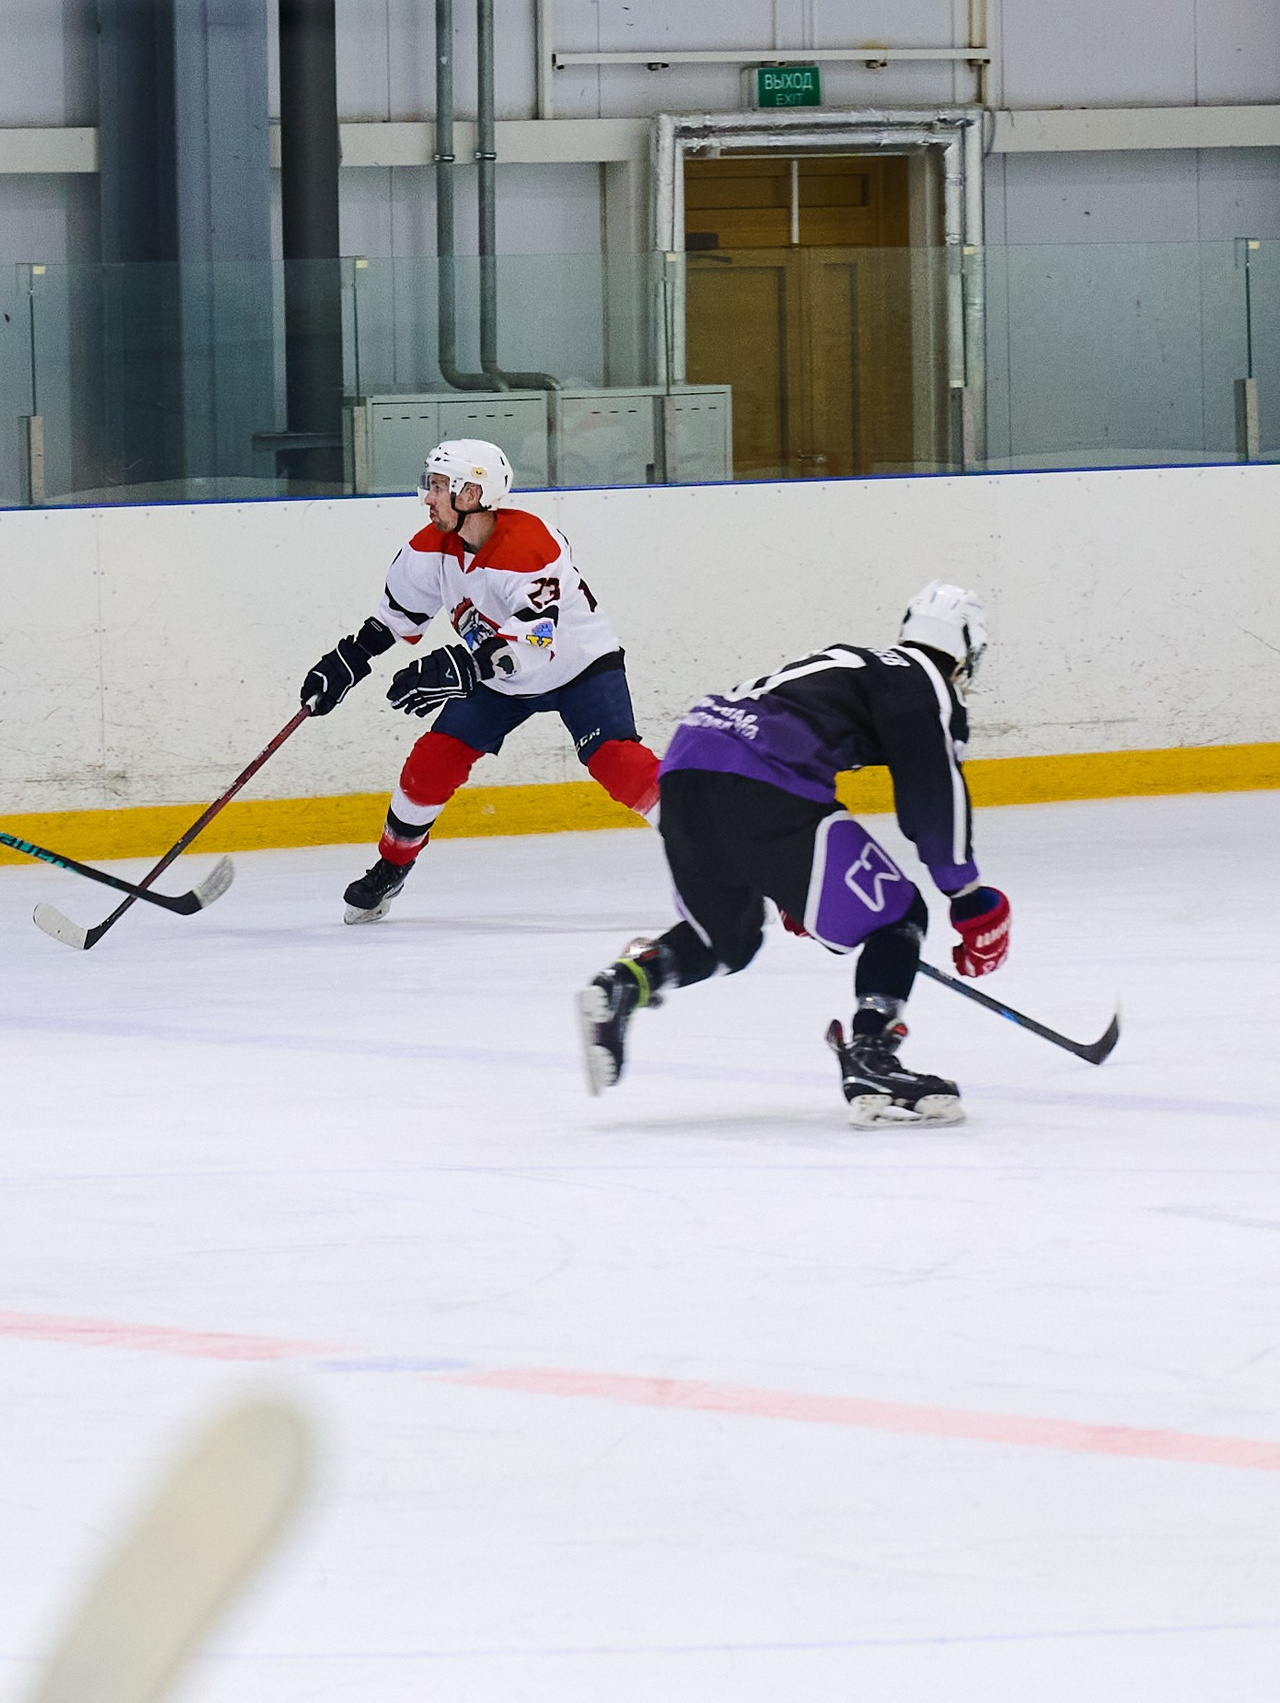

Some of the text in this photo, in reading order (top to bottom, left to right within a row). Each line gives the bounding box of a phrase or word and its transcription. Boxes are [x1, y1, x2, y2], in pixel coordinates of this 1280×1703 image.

[765, 73, 813, 91] ВЫХОД
[776, 93, 804, 106] EXIT
[527, 577, 561, 610] 23
